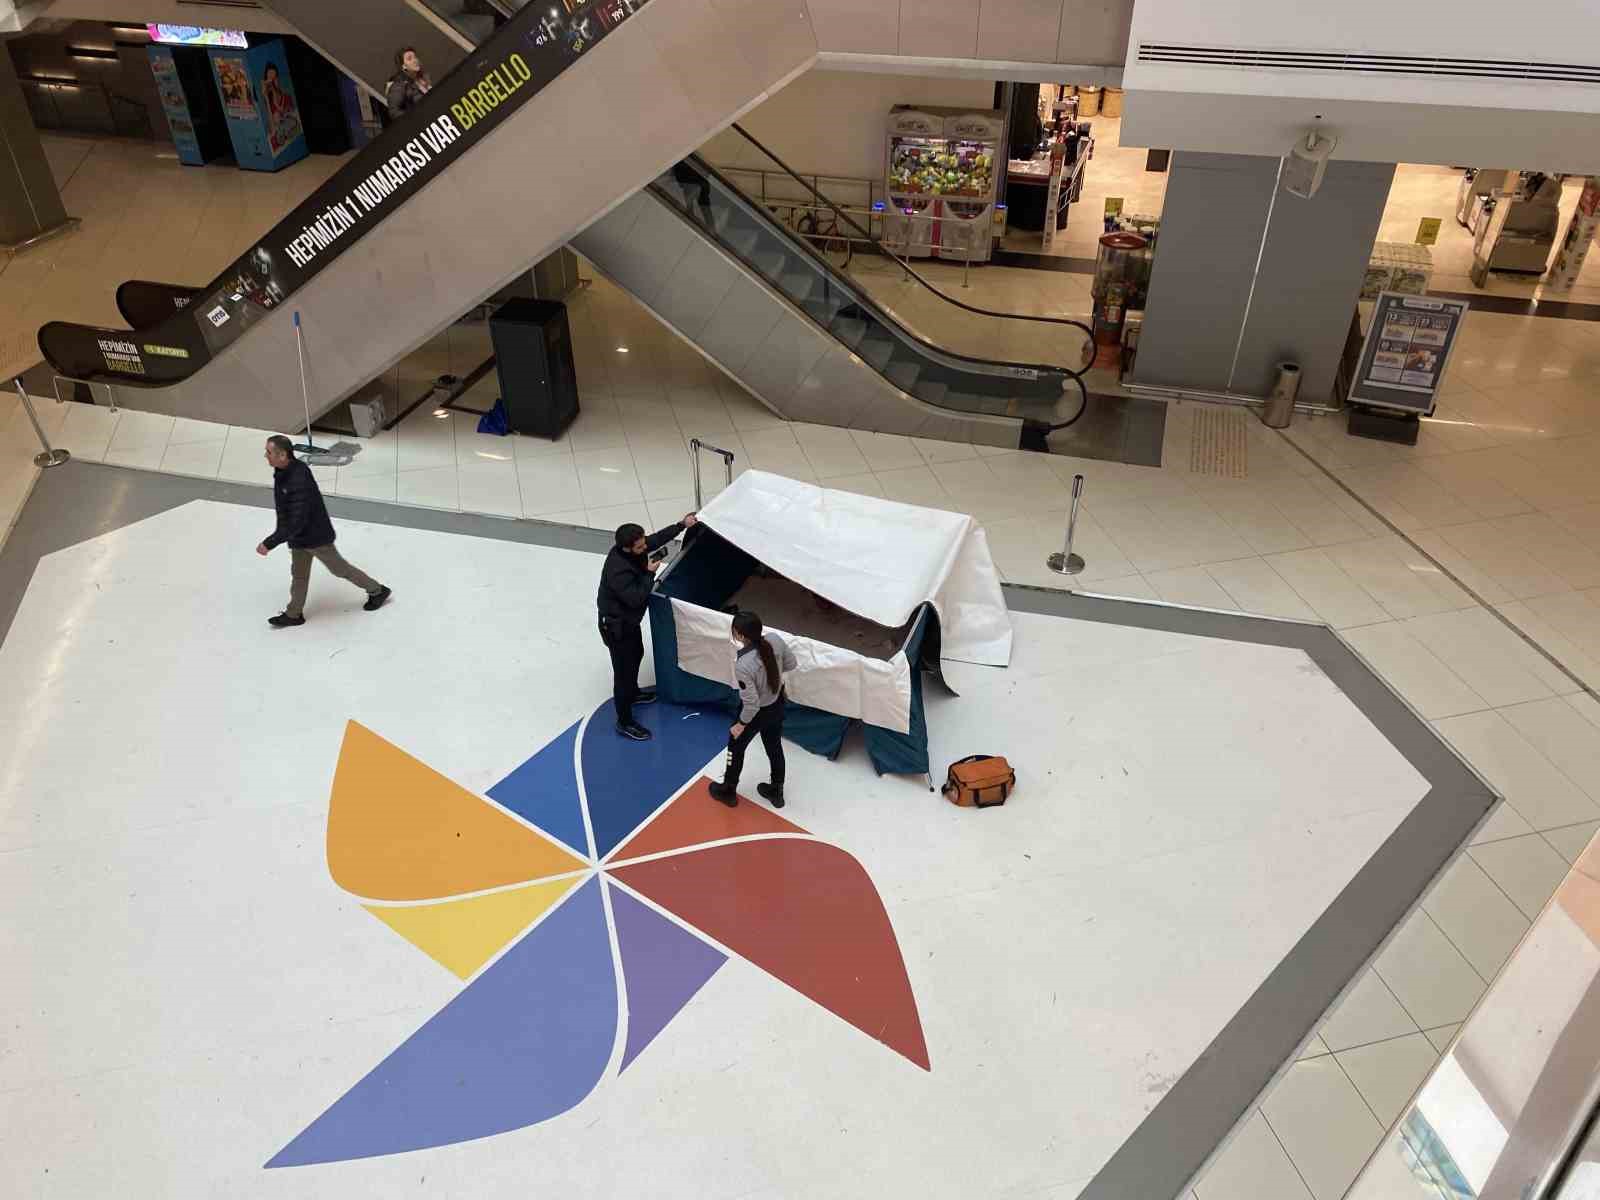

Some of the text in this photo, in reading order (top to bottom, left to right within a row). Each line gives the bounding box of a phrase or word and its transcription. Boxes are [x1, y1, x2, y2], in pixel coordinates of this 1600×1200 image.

[285, 53, 531, 268] HEPİMİZİN 1 NUMARASI VAR BARGELLO
